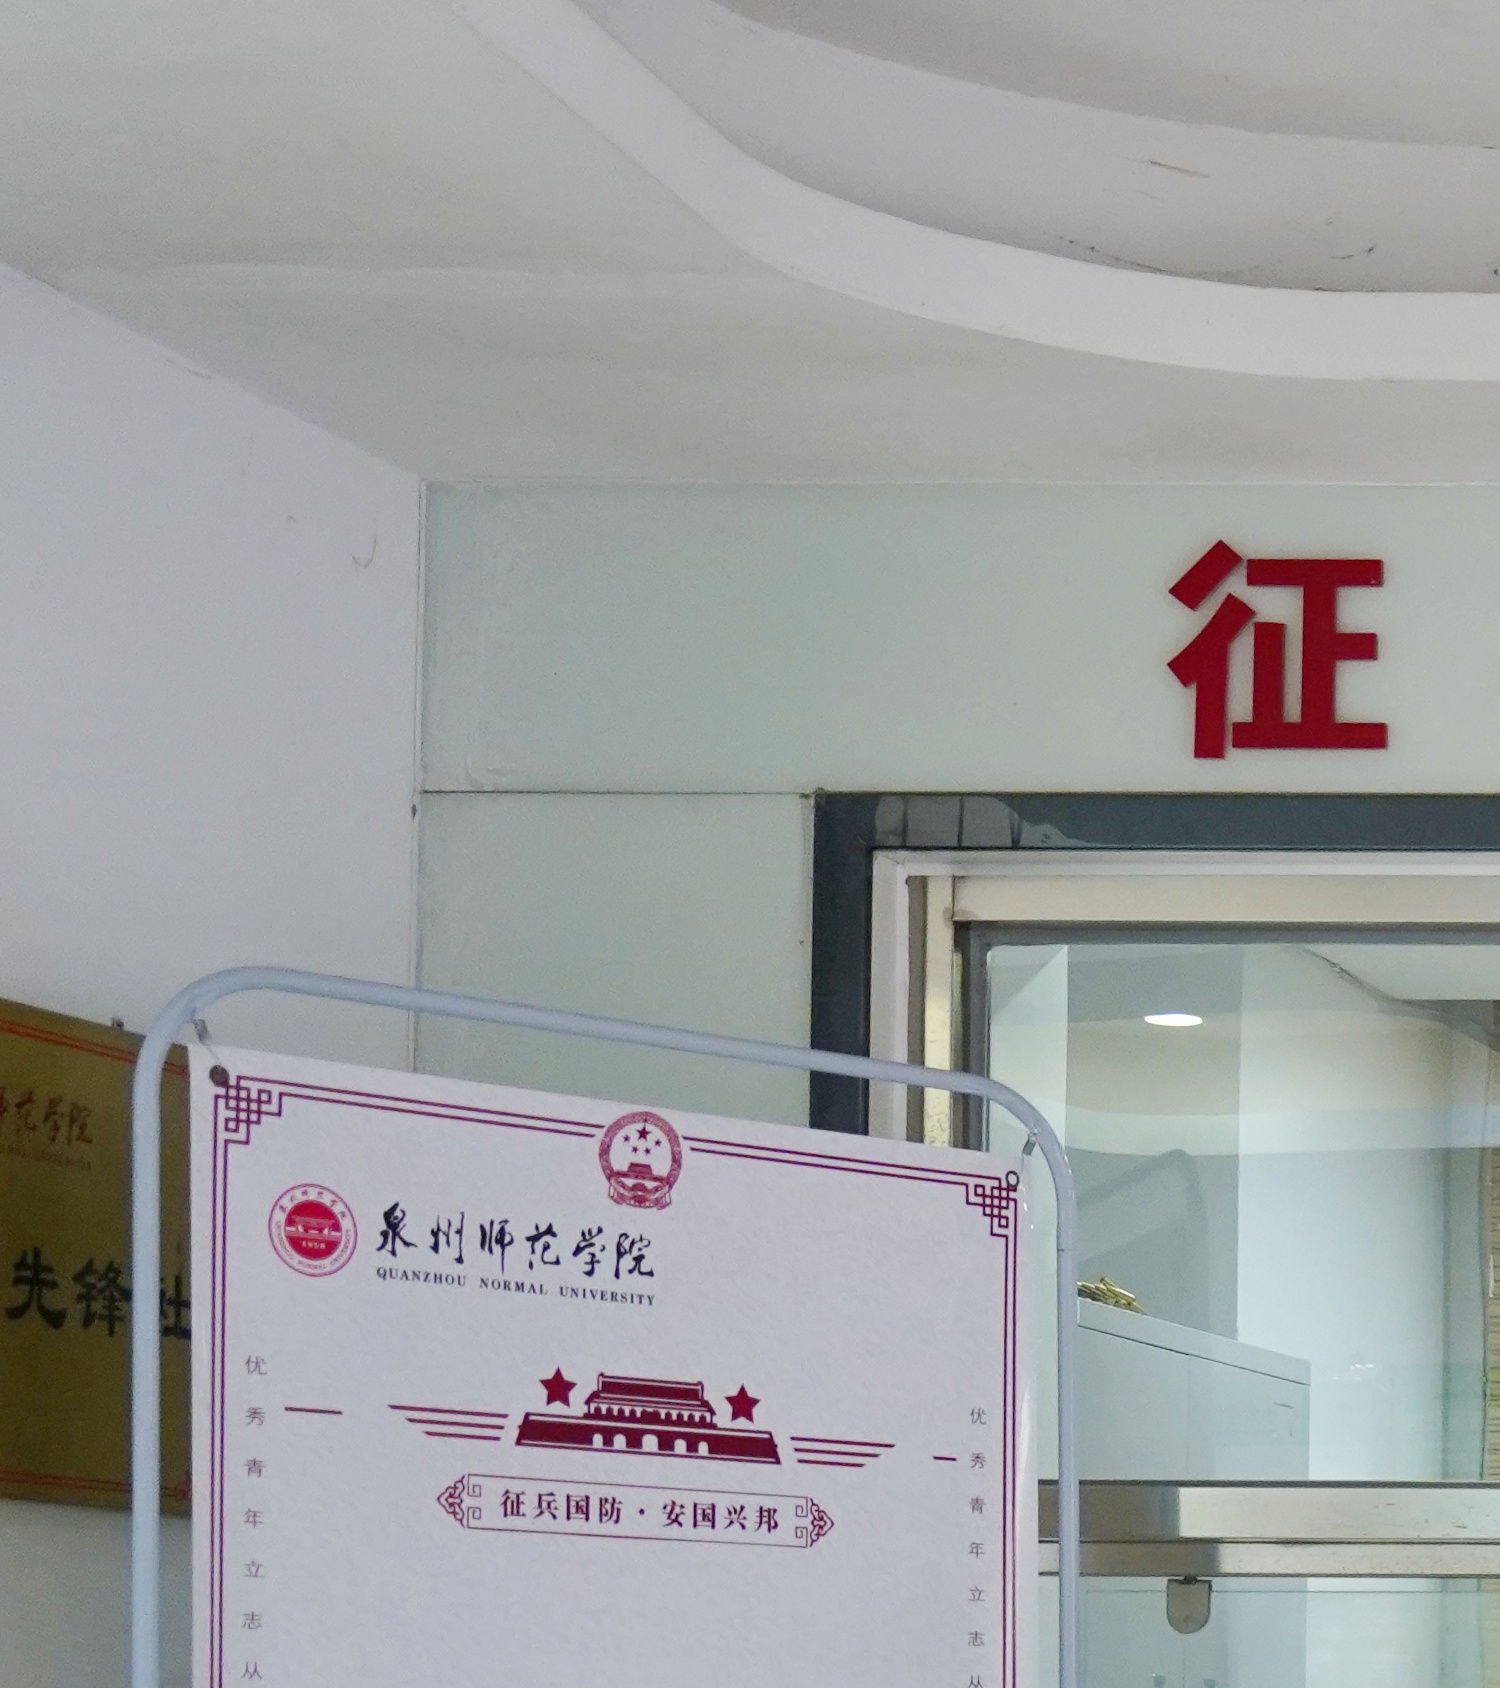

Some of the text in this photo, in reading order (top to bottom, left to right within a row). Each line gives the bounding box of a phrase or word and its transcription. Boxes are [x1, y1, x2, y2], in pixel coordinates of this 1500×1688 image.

[376, 1202, 654, 1278] 泉州师范学院
[376, 1266, 656, 1307] QUANZHOU NORMAL UNIVERSITY
